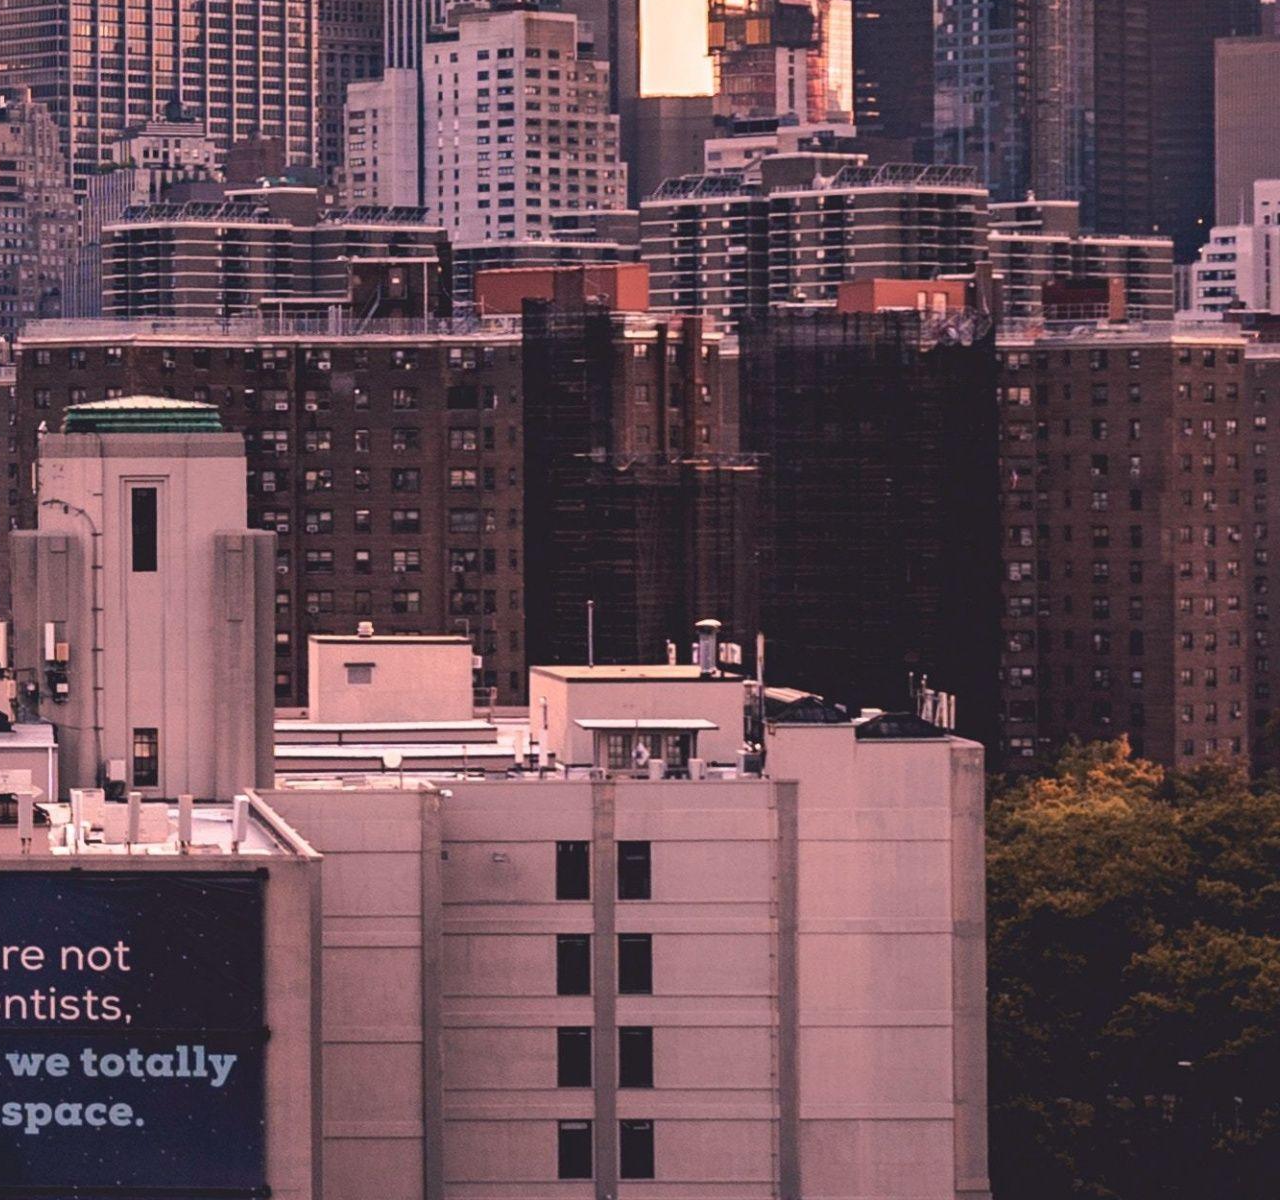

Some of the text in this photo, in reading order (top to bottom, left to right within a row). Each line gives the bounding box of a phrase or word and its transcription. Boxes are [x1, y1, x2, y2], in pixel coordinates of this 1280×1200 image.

[61, 940, 131, 971] not
[6, 1052, 70, 1077] we
[80, 1045, 237, 1087] totally
[2, 1099, 144, 1134] space.
